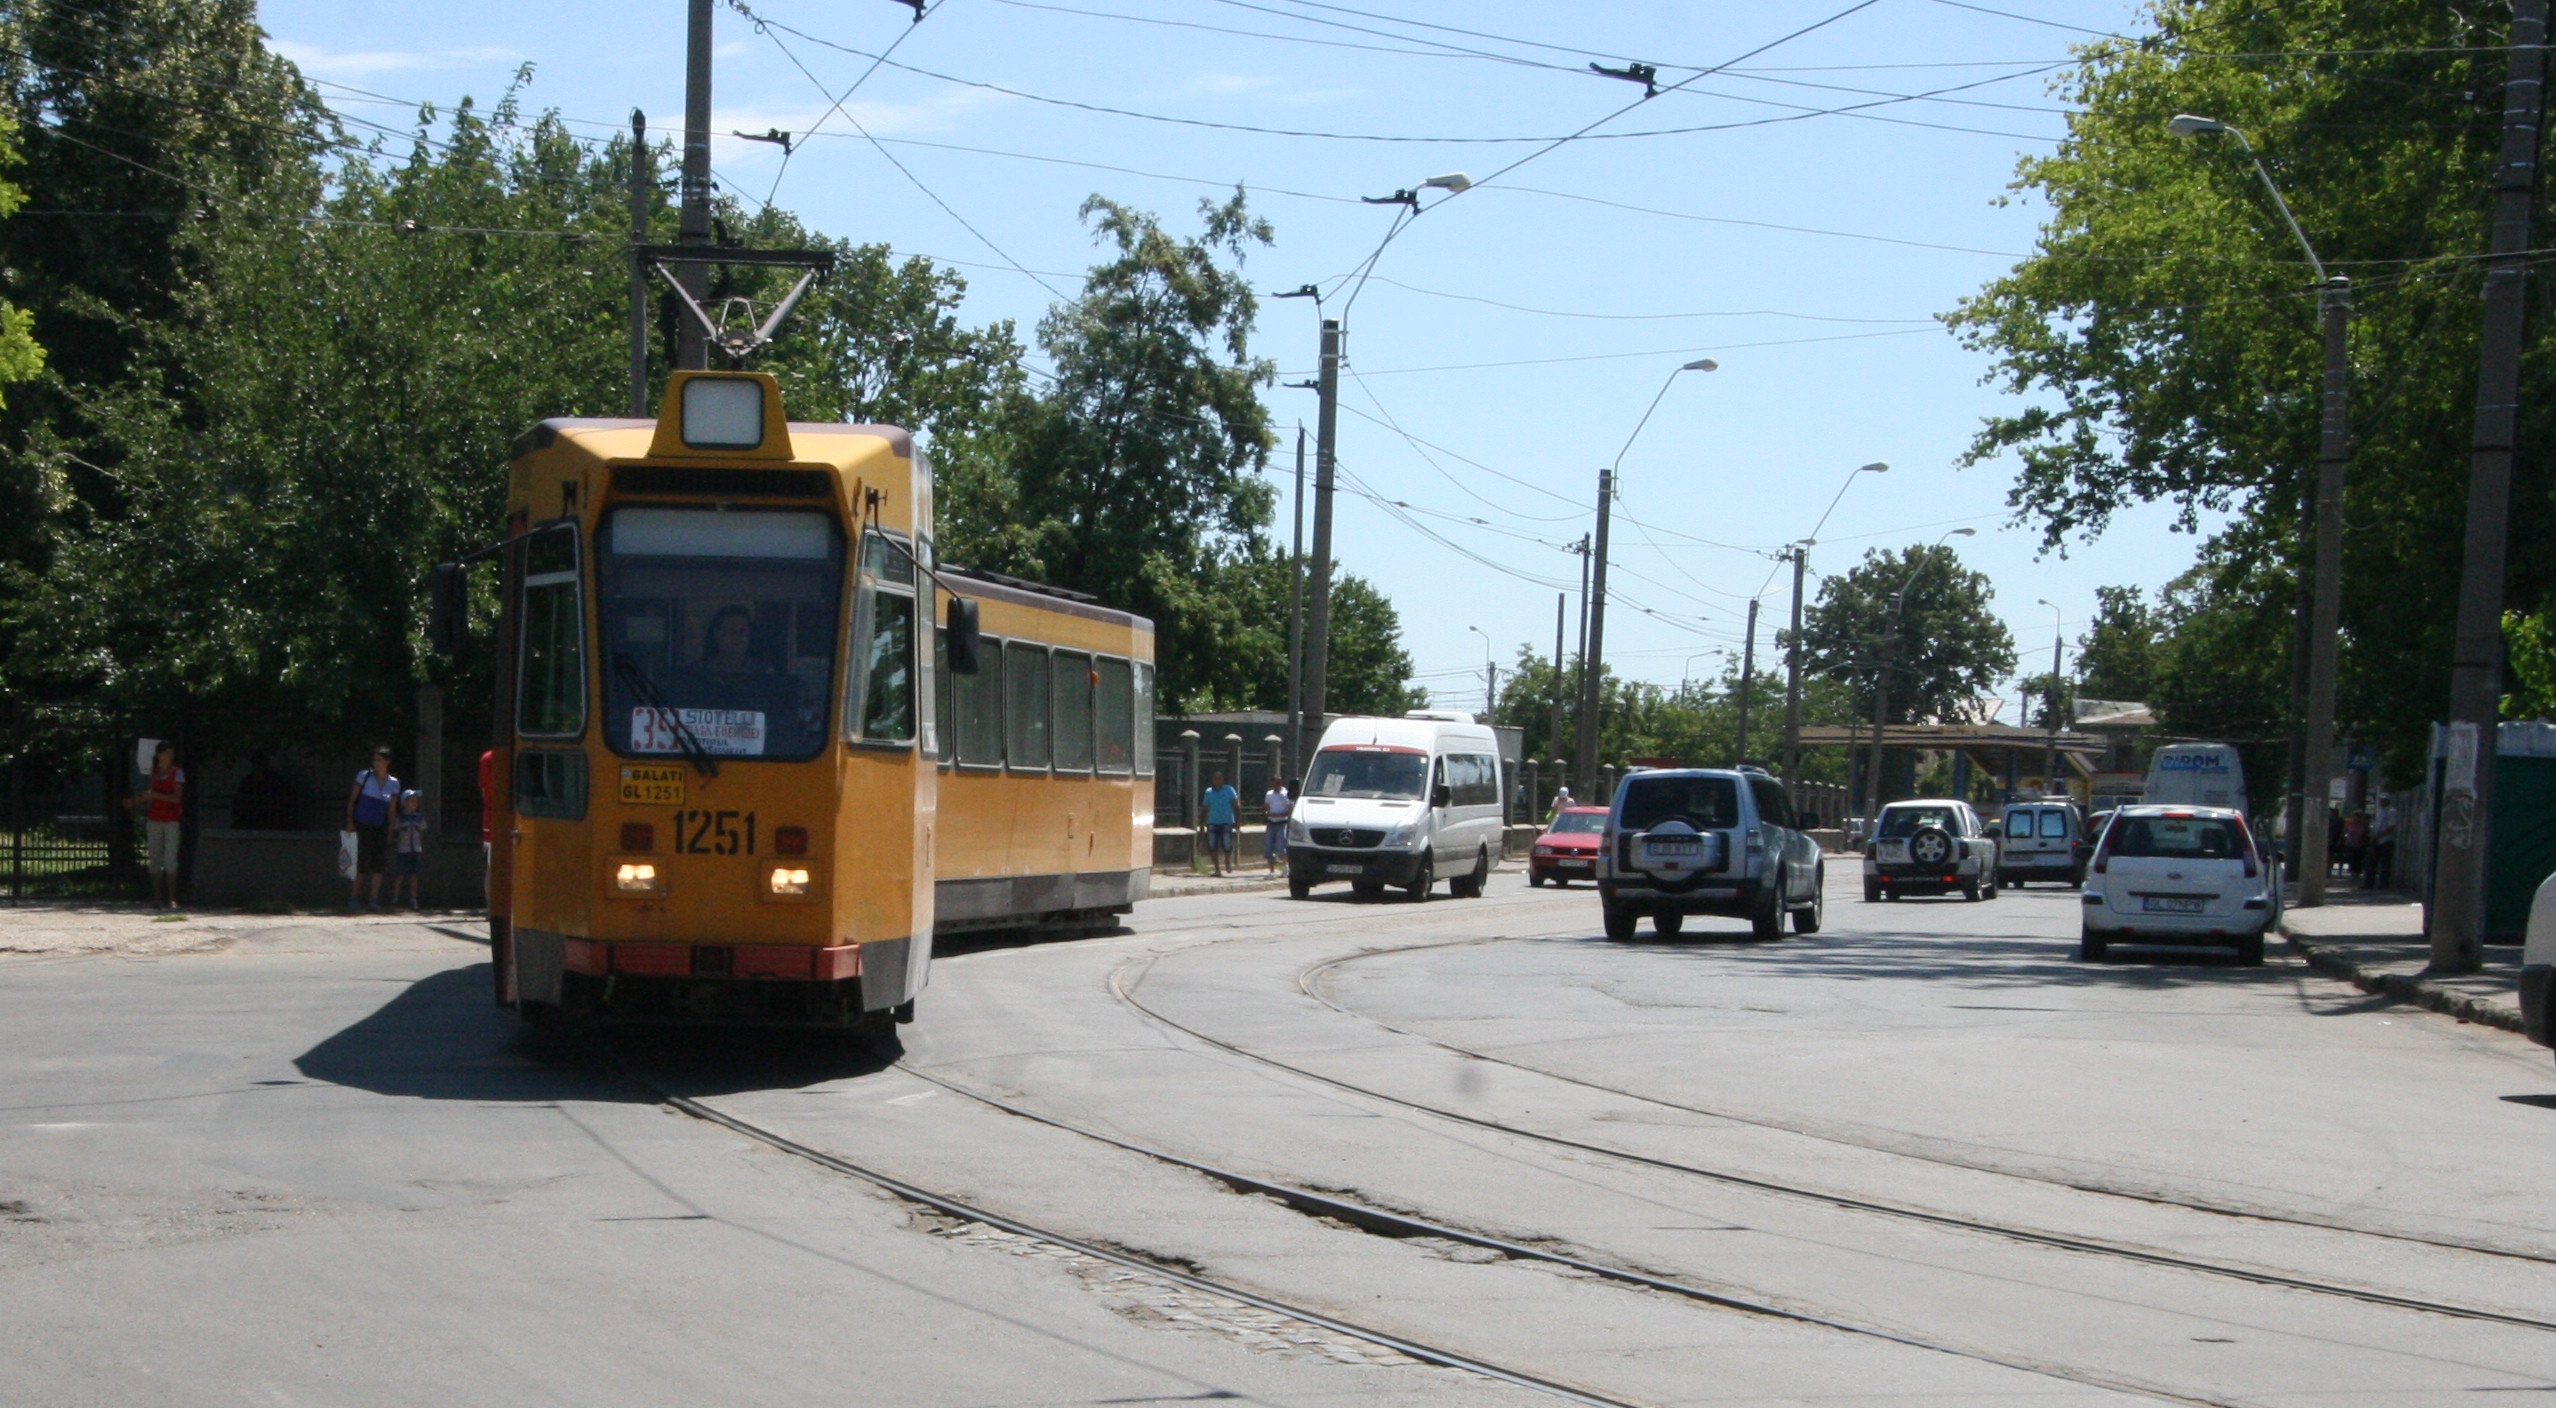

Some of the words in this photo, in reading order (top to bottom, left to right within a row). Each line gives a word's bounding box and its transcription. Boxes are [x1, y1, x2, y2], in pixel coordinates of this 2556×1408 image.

[632, 769, 684, 782] GALATI
[623, 785, 642, 799] GL
[645, 786, 681, 800] 1251
[674, 810, 756, 855] 1251
